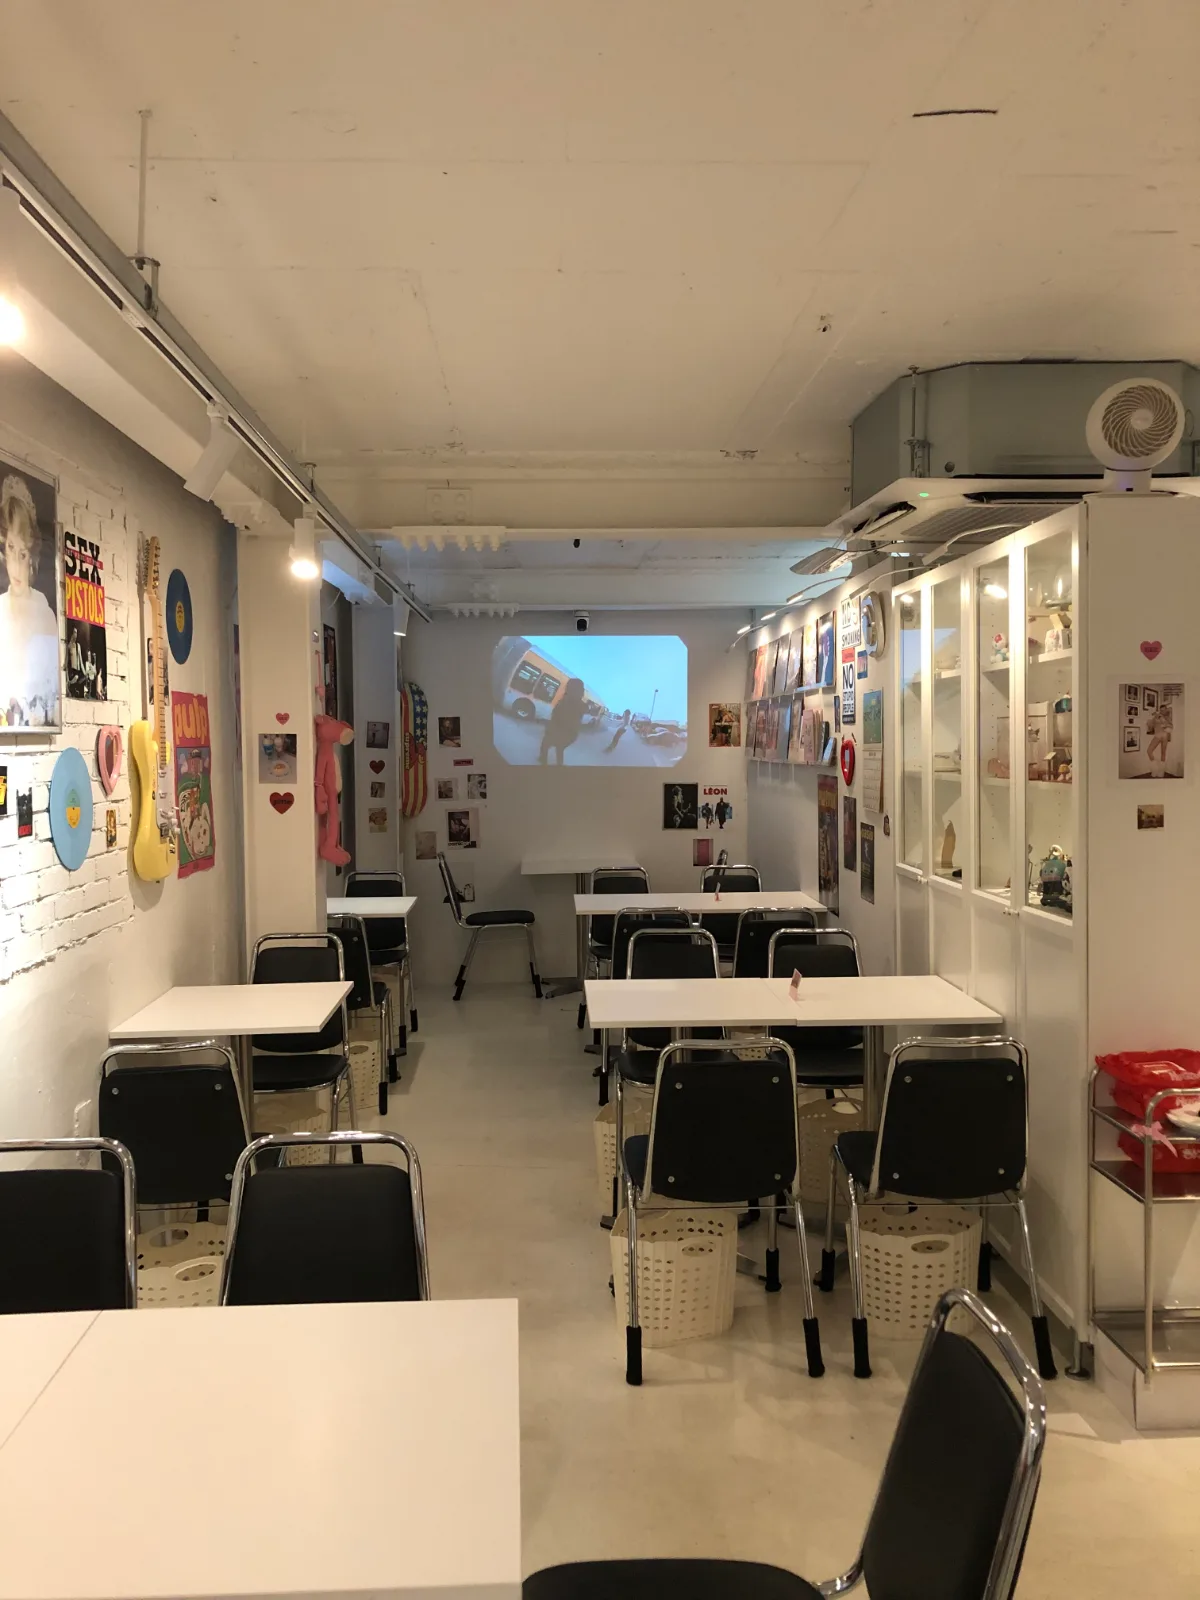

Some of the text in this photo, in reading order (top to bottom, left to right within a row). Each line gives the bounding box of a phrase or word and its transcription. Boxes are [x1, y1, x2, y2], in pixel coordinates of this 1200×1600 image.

[65, 531, 102, 586] SEX
[65, 577, 104, 625] PISTOLS
[842, 629, 860, 647] SMOKING
[843, 663, 854, 689] NO
[174, 697, 207, 745] pulp
